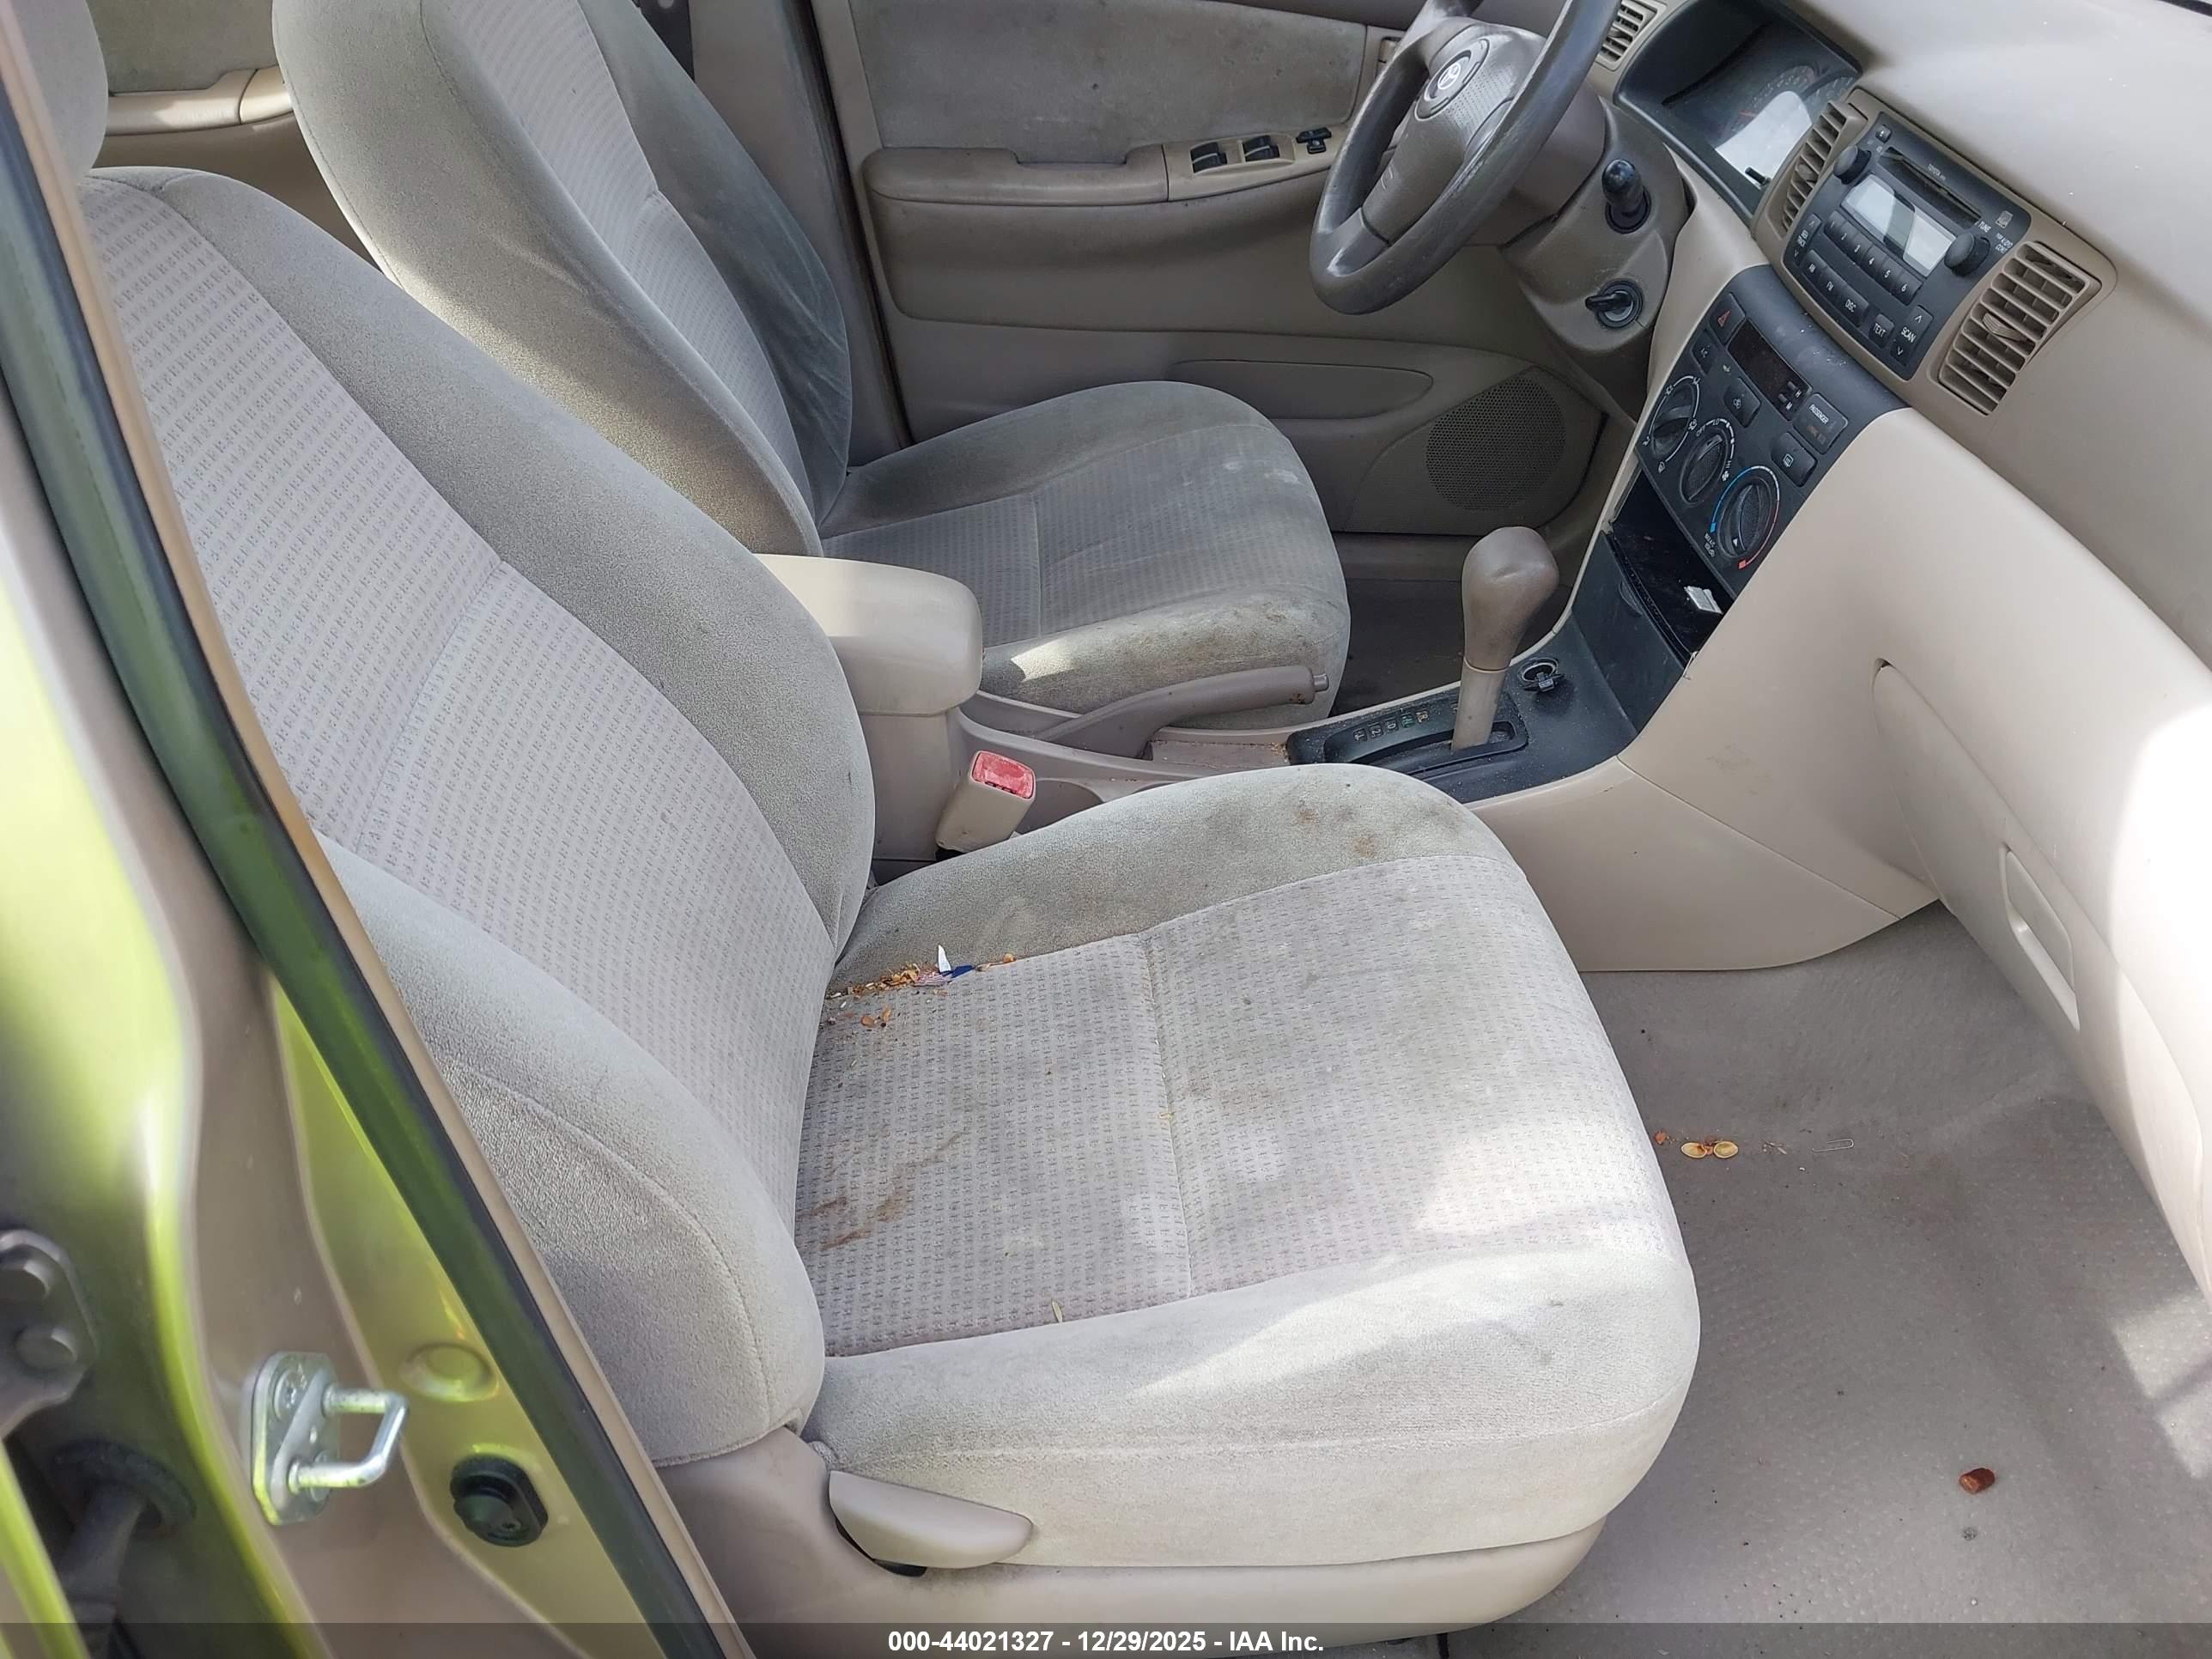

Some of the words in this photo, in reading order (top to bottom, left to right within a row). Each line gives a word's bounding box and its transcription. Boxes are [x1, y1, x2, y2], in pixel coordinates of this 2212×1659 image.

[1978, 221, 1992, 233] TUNE
[1884, 270, 1891, 278] 5
[1901, 283, 1908, 292] 6
[1844, 299, 1856, 312] DISC
[1873, 322, 1887, 337] TEXT
[1900, 326, 1917, 343] SCAN
